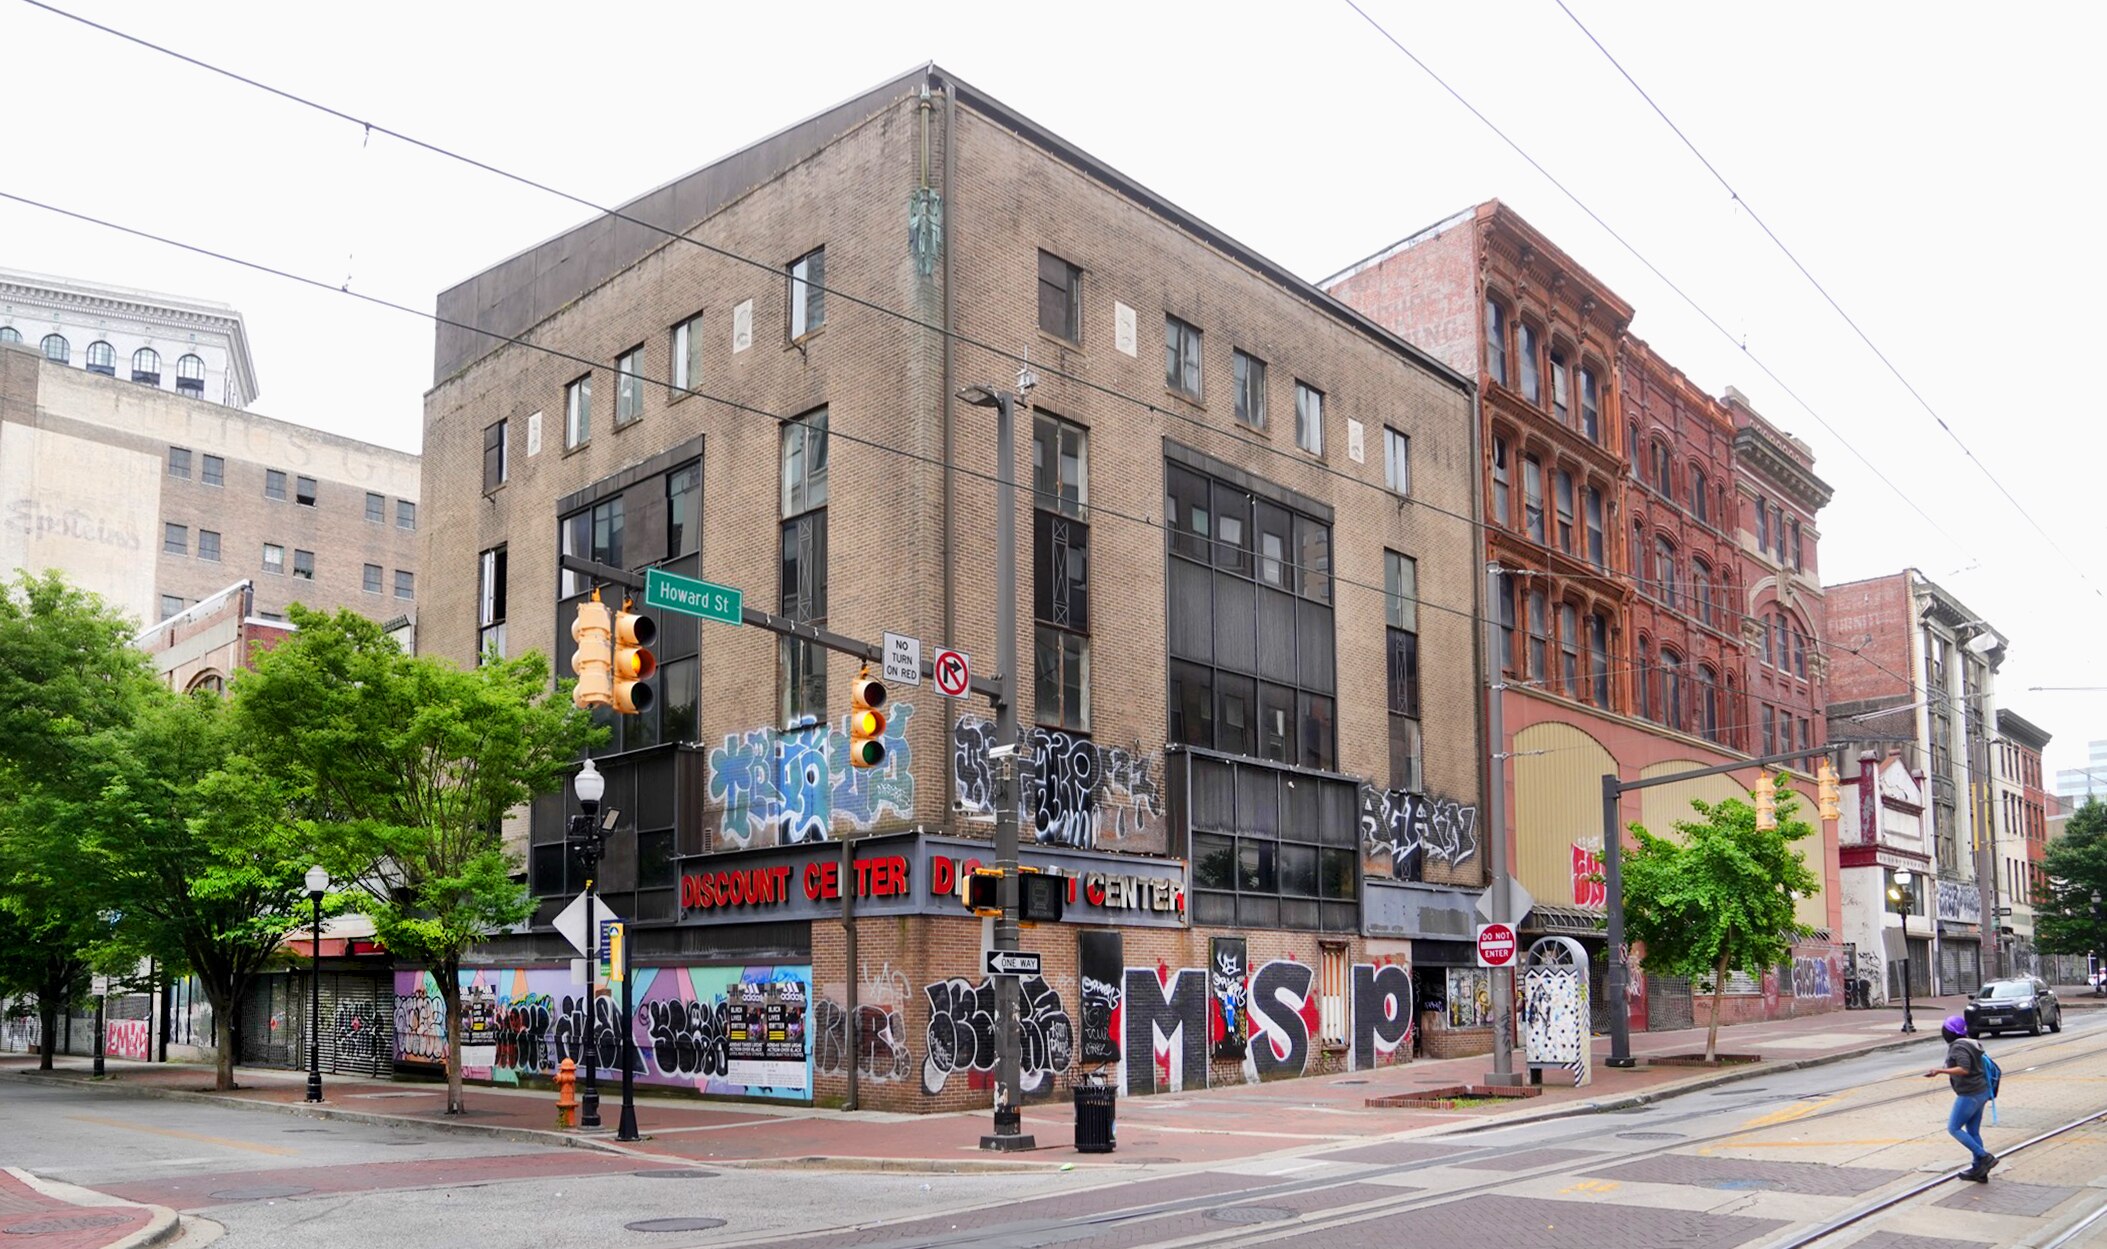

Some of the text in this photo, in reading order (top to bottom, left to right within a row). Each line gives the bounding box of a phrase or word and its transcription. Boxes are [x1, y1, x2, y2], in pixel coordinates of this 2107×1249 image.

[660, 581, 728, 612] Howard St
[896, 640, 908, 650] NO
[892, 652, 912, 665] TURN
[886, 665, 917, 680] ON RED
[681, 866, 791, 908] DISCOUNT
[1086, 872, 1185, 911] CENTER
[1496, 932, 1510, 940] NOT
[1484, 950, 1509, 958] ENTER
[1002, 958, 1036, 968] ONE WAY
